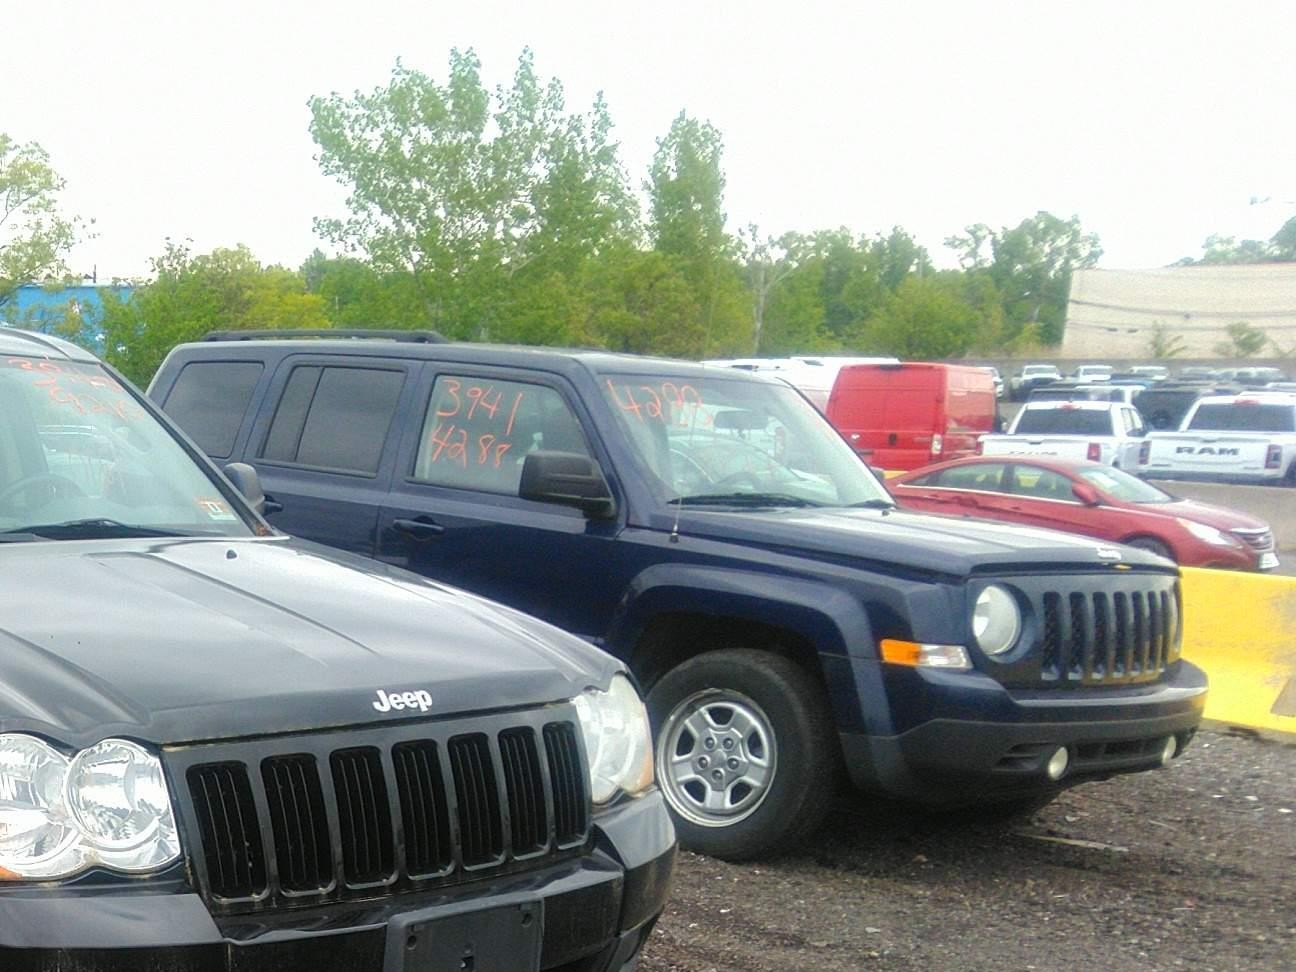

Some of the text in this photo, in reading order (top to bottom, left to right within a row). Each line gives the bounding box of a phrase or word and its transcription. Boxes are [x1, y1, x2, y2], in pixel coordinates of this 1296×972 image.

[436, 379, 523, 436] 3941
[431, 423, 512, 468] 4288
[1175, 446, 1240, 456] RAM
[372, 689, 433, 712] Jeep
